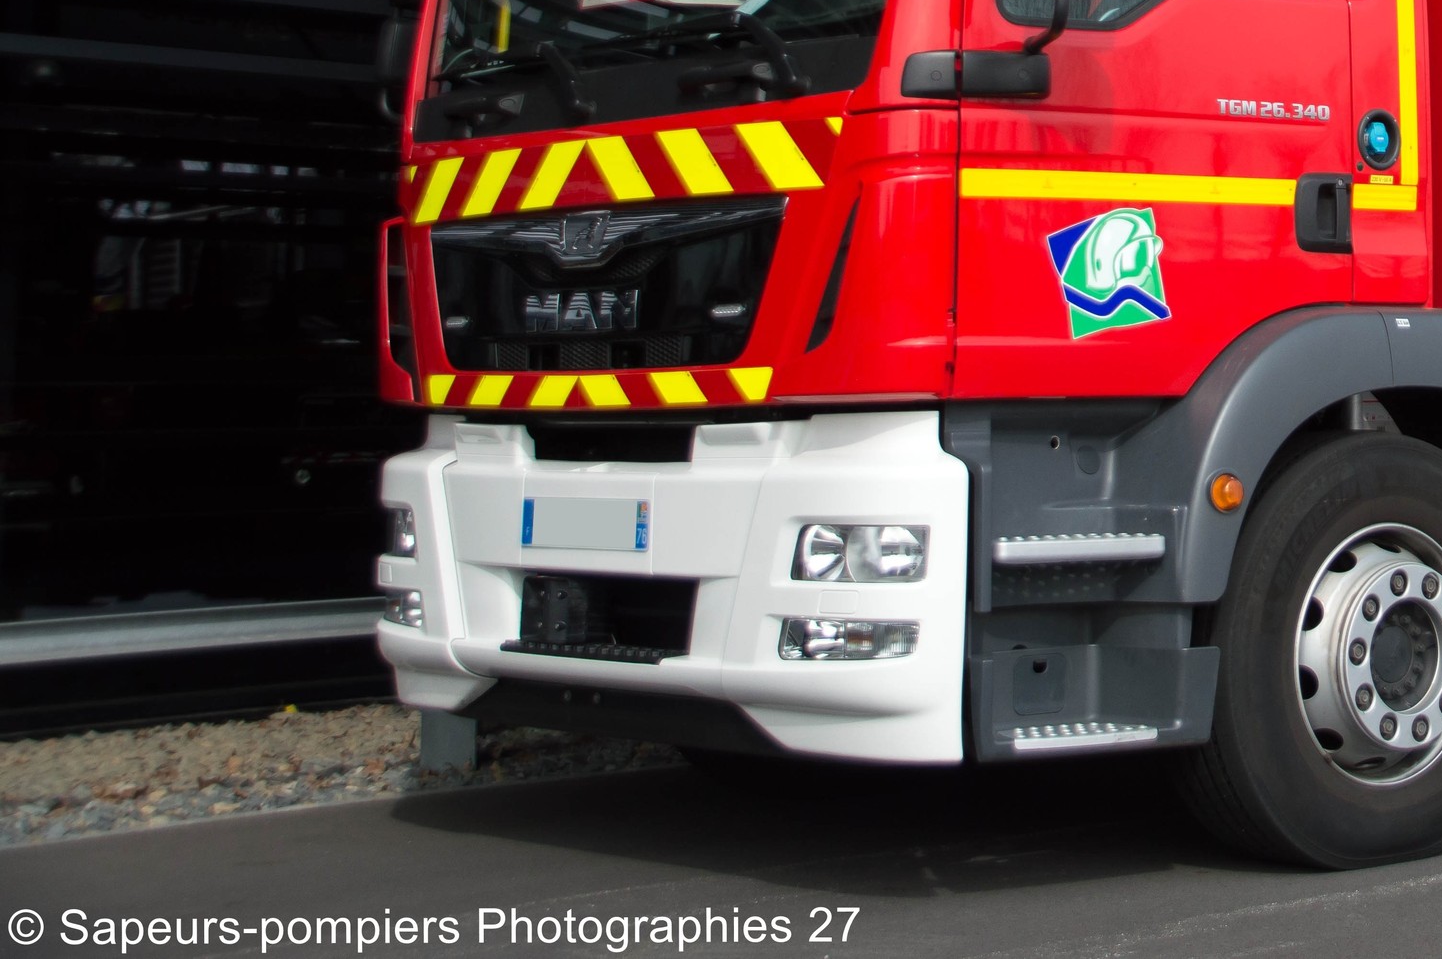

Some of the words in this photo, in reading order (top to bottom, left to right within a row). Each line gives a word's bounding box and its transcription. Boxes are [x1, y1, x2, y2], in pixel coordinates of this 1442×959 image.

[1217, 98, 1257, 116] TGM
[1260, 101, 1330, 121] 26.340
[526, 289, 639, 333] MAN
[636, 527, 648, 545] 76
